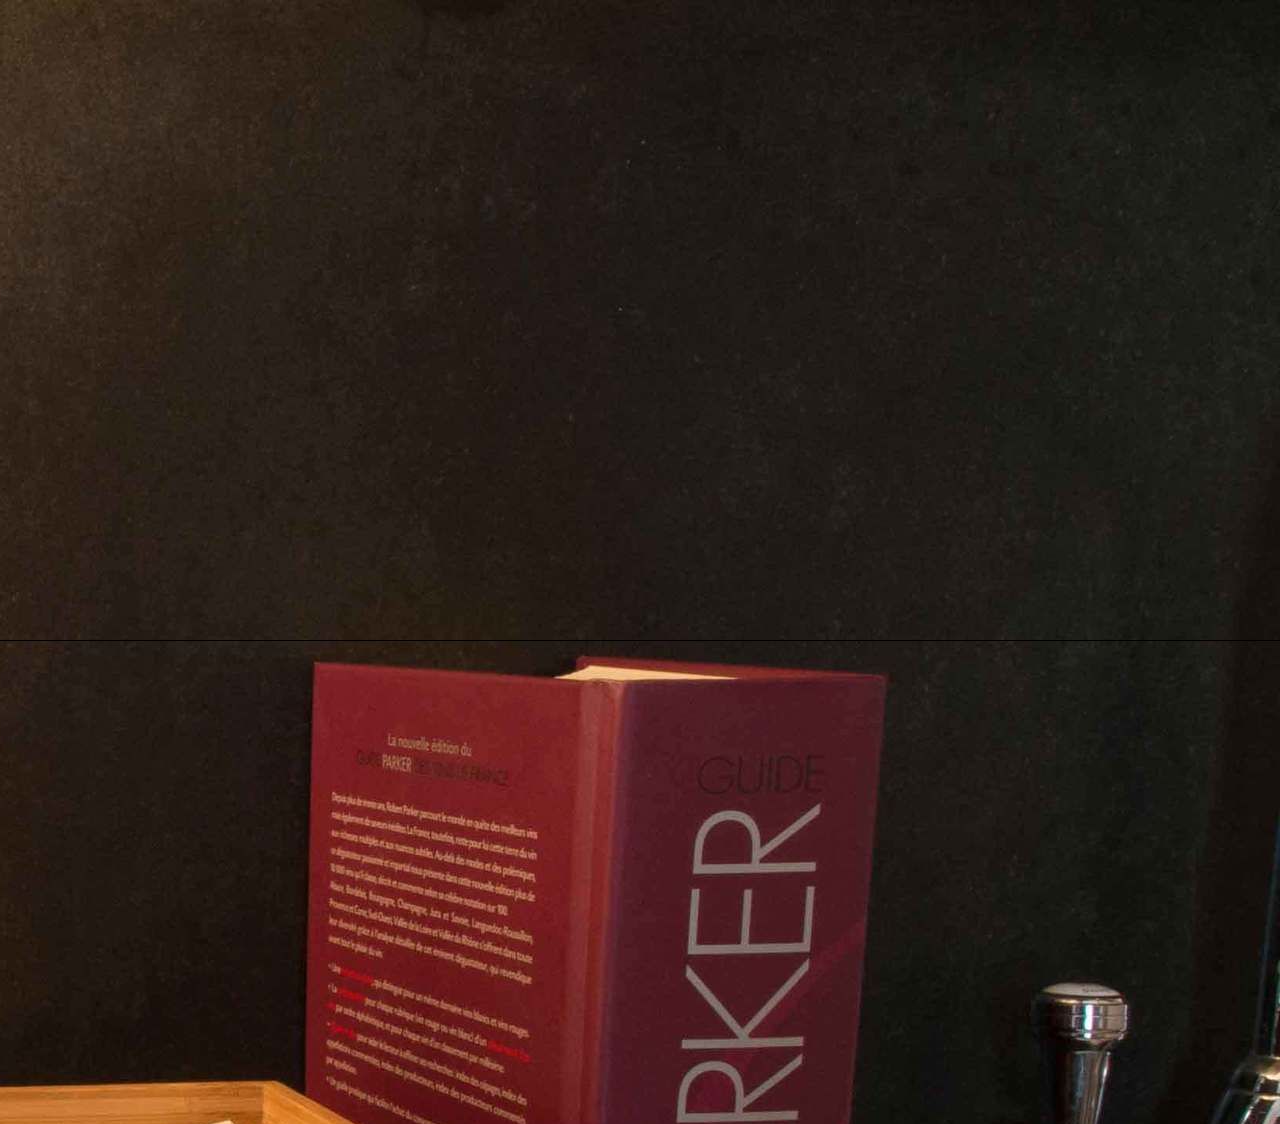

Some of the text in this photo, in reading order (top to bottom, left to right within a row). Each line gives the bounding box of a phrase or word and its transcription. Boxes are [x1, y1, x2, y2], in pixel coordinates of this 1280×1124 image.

[388, 733, 472, 756] La nouvelle édition du
[382, 754, 412, 773] PARKER
[697, 754, 826, 795] GUIDE
